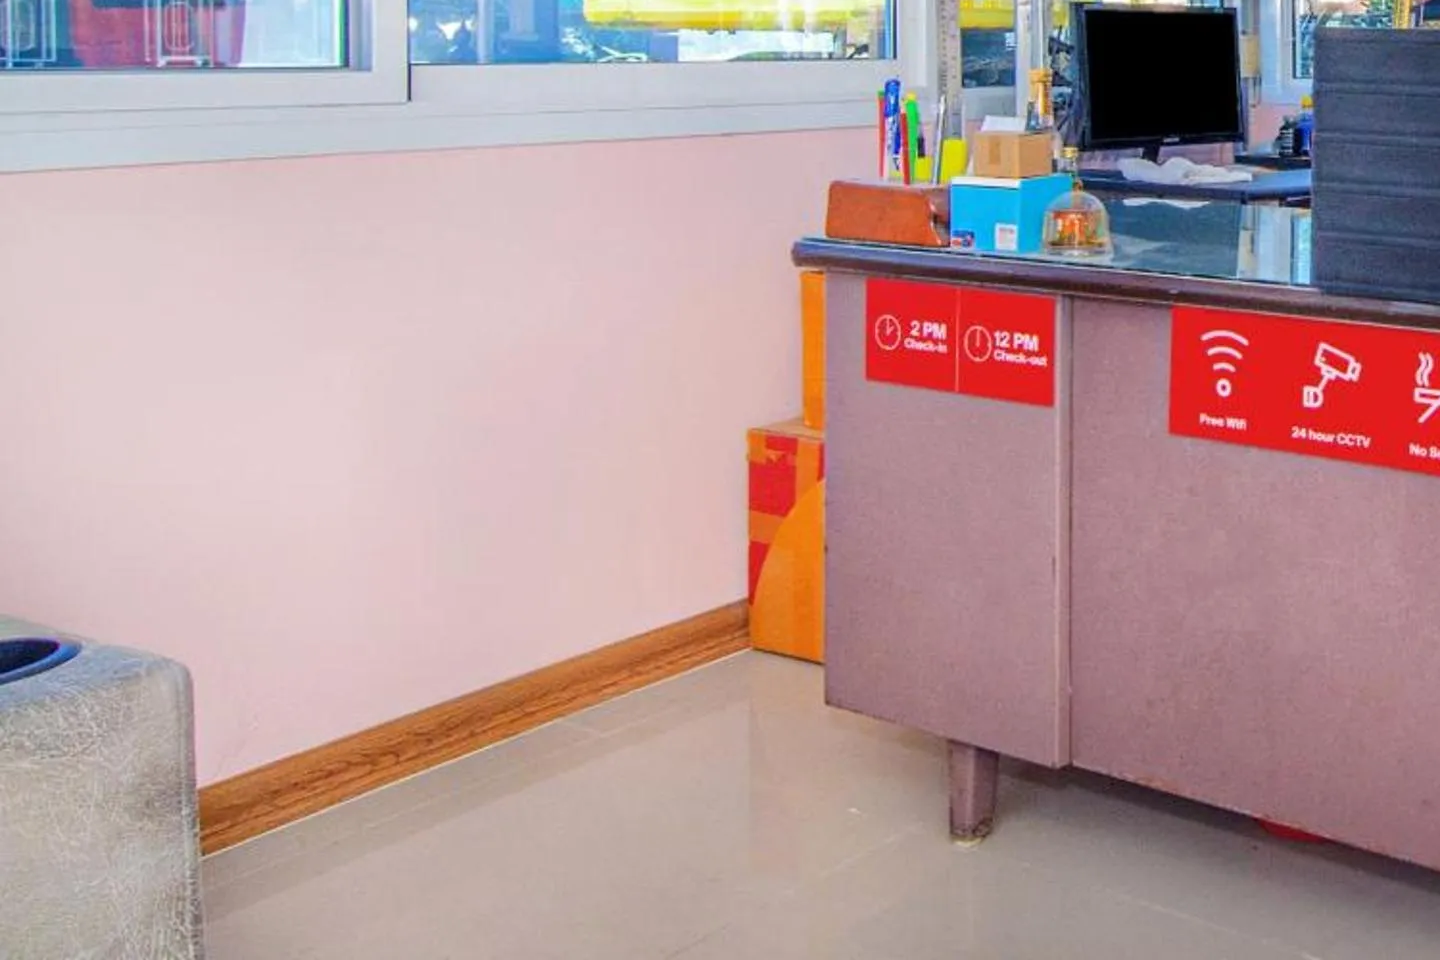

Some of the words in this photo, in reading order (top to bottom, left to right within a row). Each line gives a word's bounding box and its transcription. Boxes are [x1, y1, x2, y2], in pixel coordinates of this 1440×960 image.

[910, 320, 921, 337] 2
[922, 321, 948, 340] PM
[993, 330, 1011, 349] 12
[1012, 332, 1040, 353] PM
[993, 351, 1048, 367] Check-out
[1199, 413, 1224, 429] Free
[1291, 427, 1307, 441] 24
[1308, 428, 1335, 445] hour
[1336, 431, 1372, 449] CCTV
[1409, 443, 1428, 458] No
